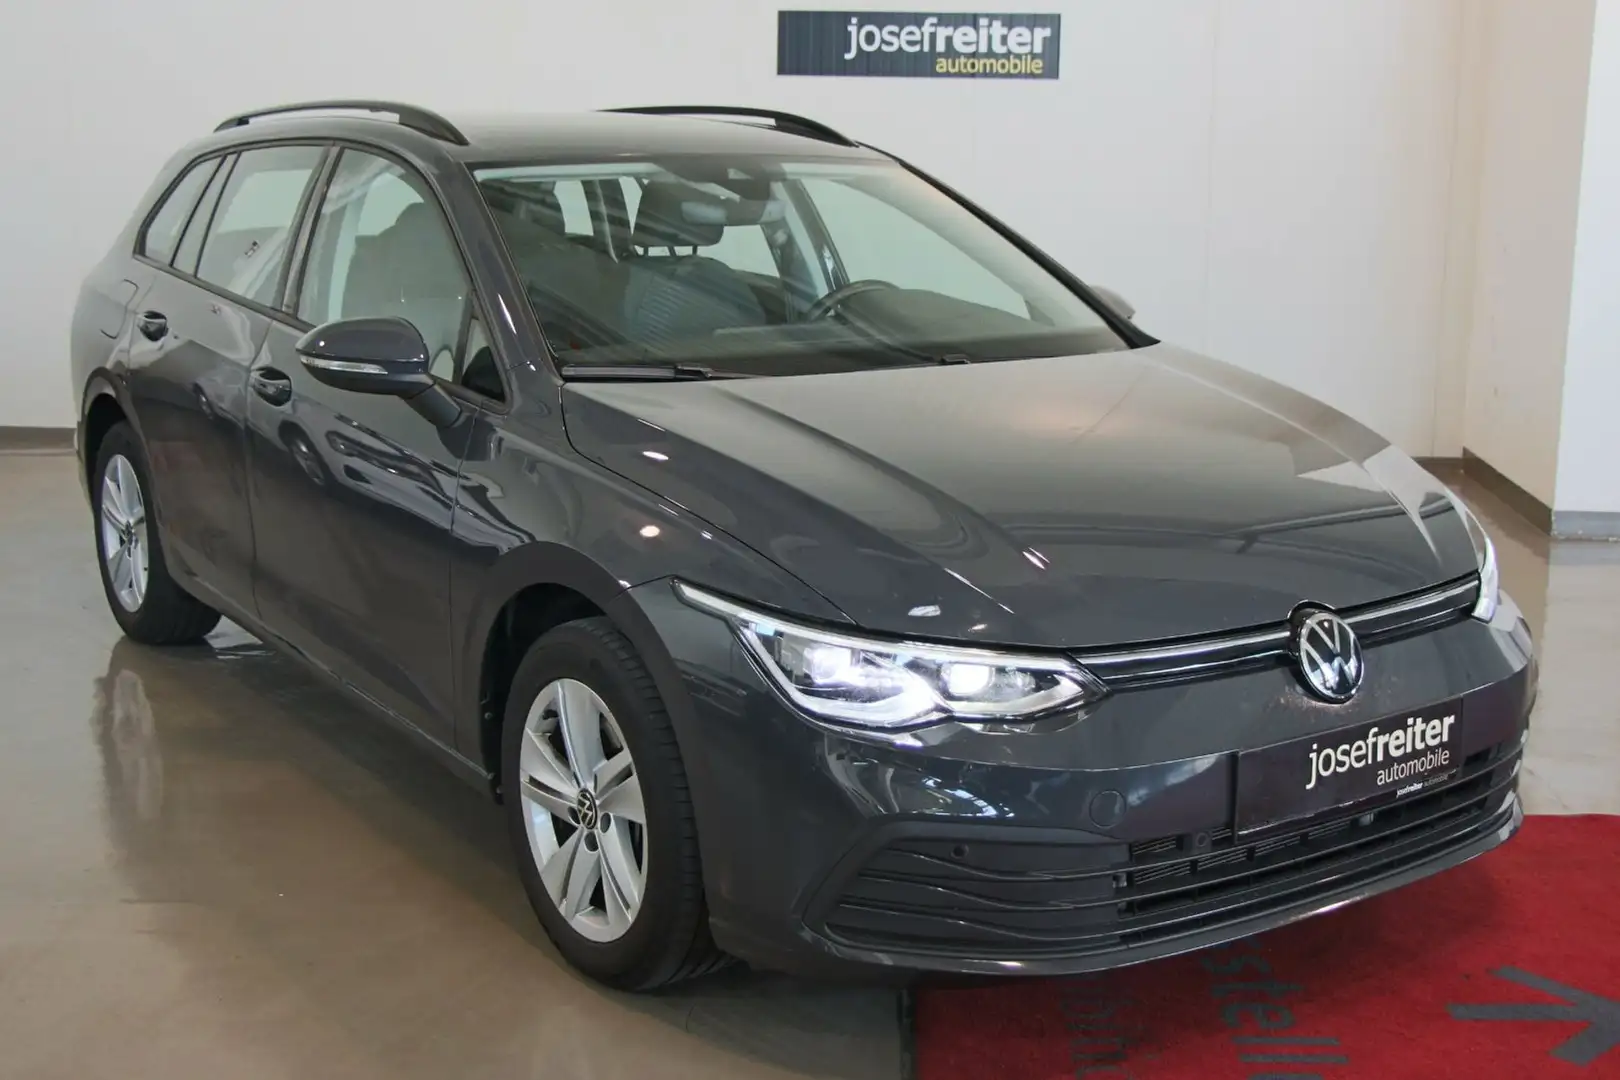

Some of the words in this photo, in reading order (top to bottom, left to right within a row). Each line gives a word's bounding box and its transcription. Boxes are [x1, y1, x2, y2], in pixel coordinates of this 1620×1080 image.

[844, 17, 1052, 60] josefreiter
[935, 55, 1044, 74] automobile
[1305, 714, 1456, 789] josefreiter
[1376, 748, 1450, 786] automobile
